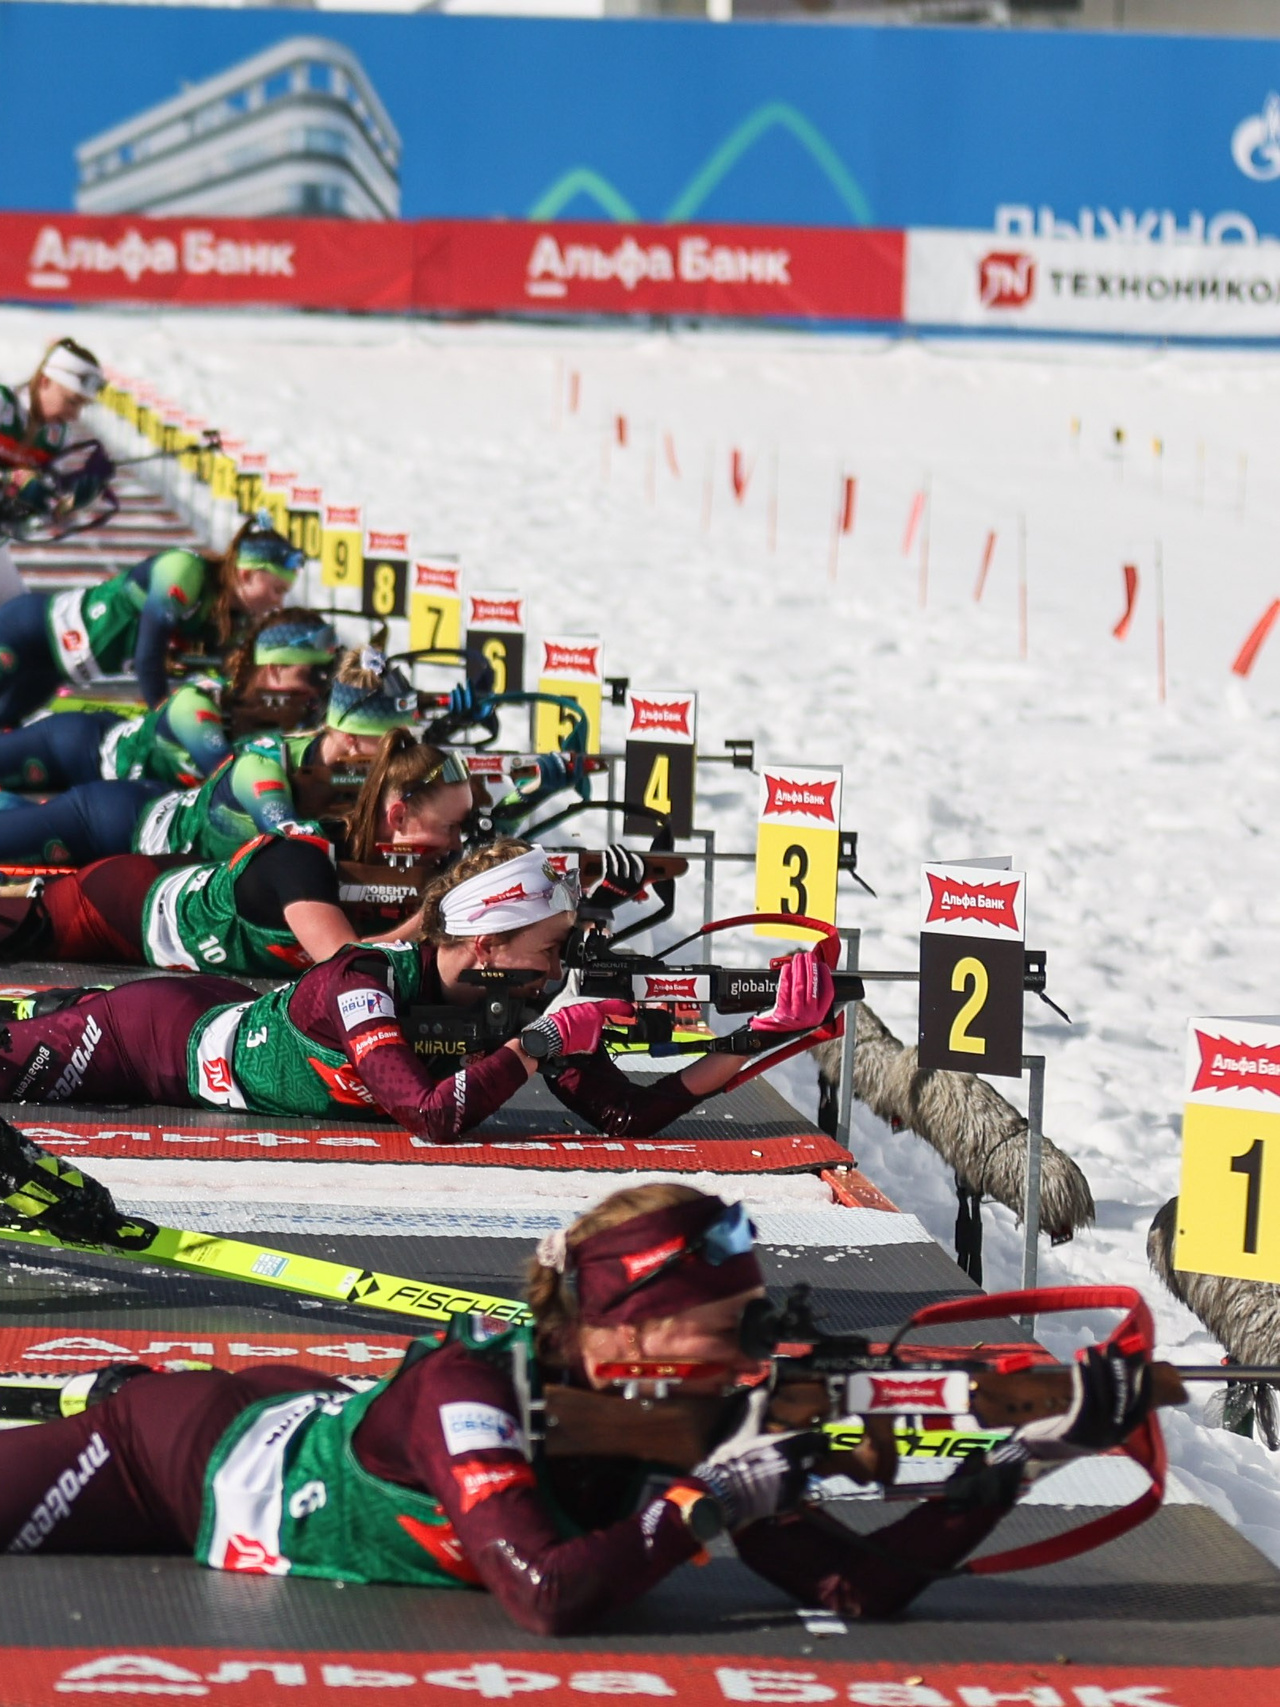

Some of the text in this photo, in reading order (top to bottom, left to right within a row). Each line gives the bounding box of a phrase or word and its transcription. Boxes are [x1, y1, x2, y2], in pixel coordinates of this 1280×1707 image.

[28, 226, 295, 287] Альфа Банк
[526, 234, 792, 295] Альфа Банк
[334, 540, 349, 580] 9
[372, 563, 397, 616] 8
[427, 606, 444, 652] 7
[639, 709, 682, 723] Альфа Банк
[644, 754, 671, 822] 4
[775, 788, 825, 806] Альфа Банк
[780, 843, 809, 917] 3
[941, 891, 1005, 910] Альфа Банк
[198, 935, 227, 963] 10
[342, 999, 366, 1014] RBU
[949, 956, 989, 1055] 2
[246, 1026, 268, 1048] 3
[1211, 1053, 1257, 1076] Альфа
[1230, 1138, 1264, 1255] 1
[388, 1285, 535, 1324] FISCHER
[20, 1336, 406, 1363] Альф
[55, 1654, 1178, 1707] Альфа Банк
